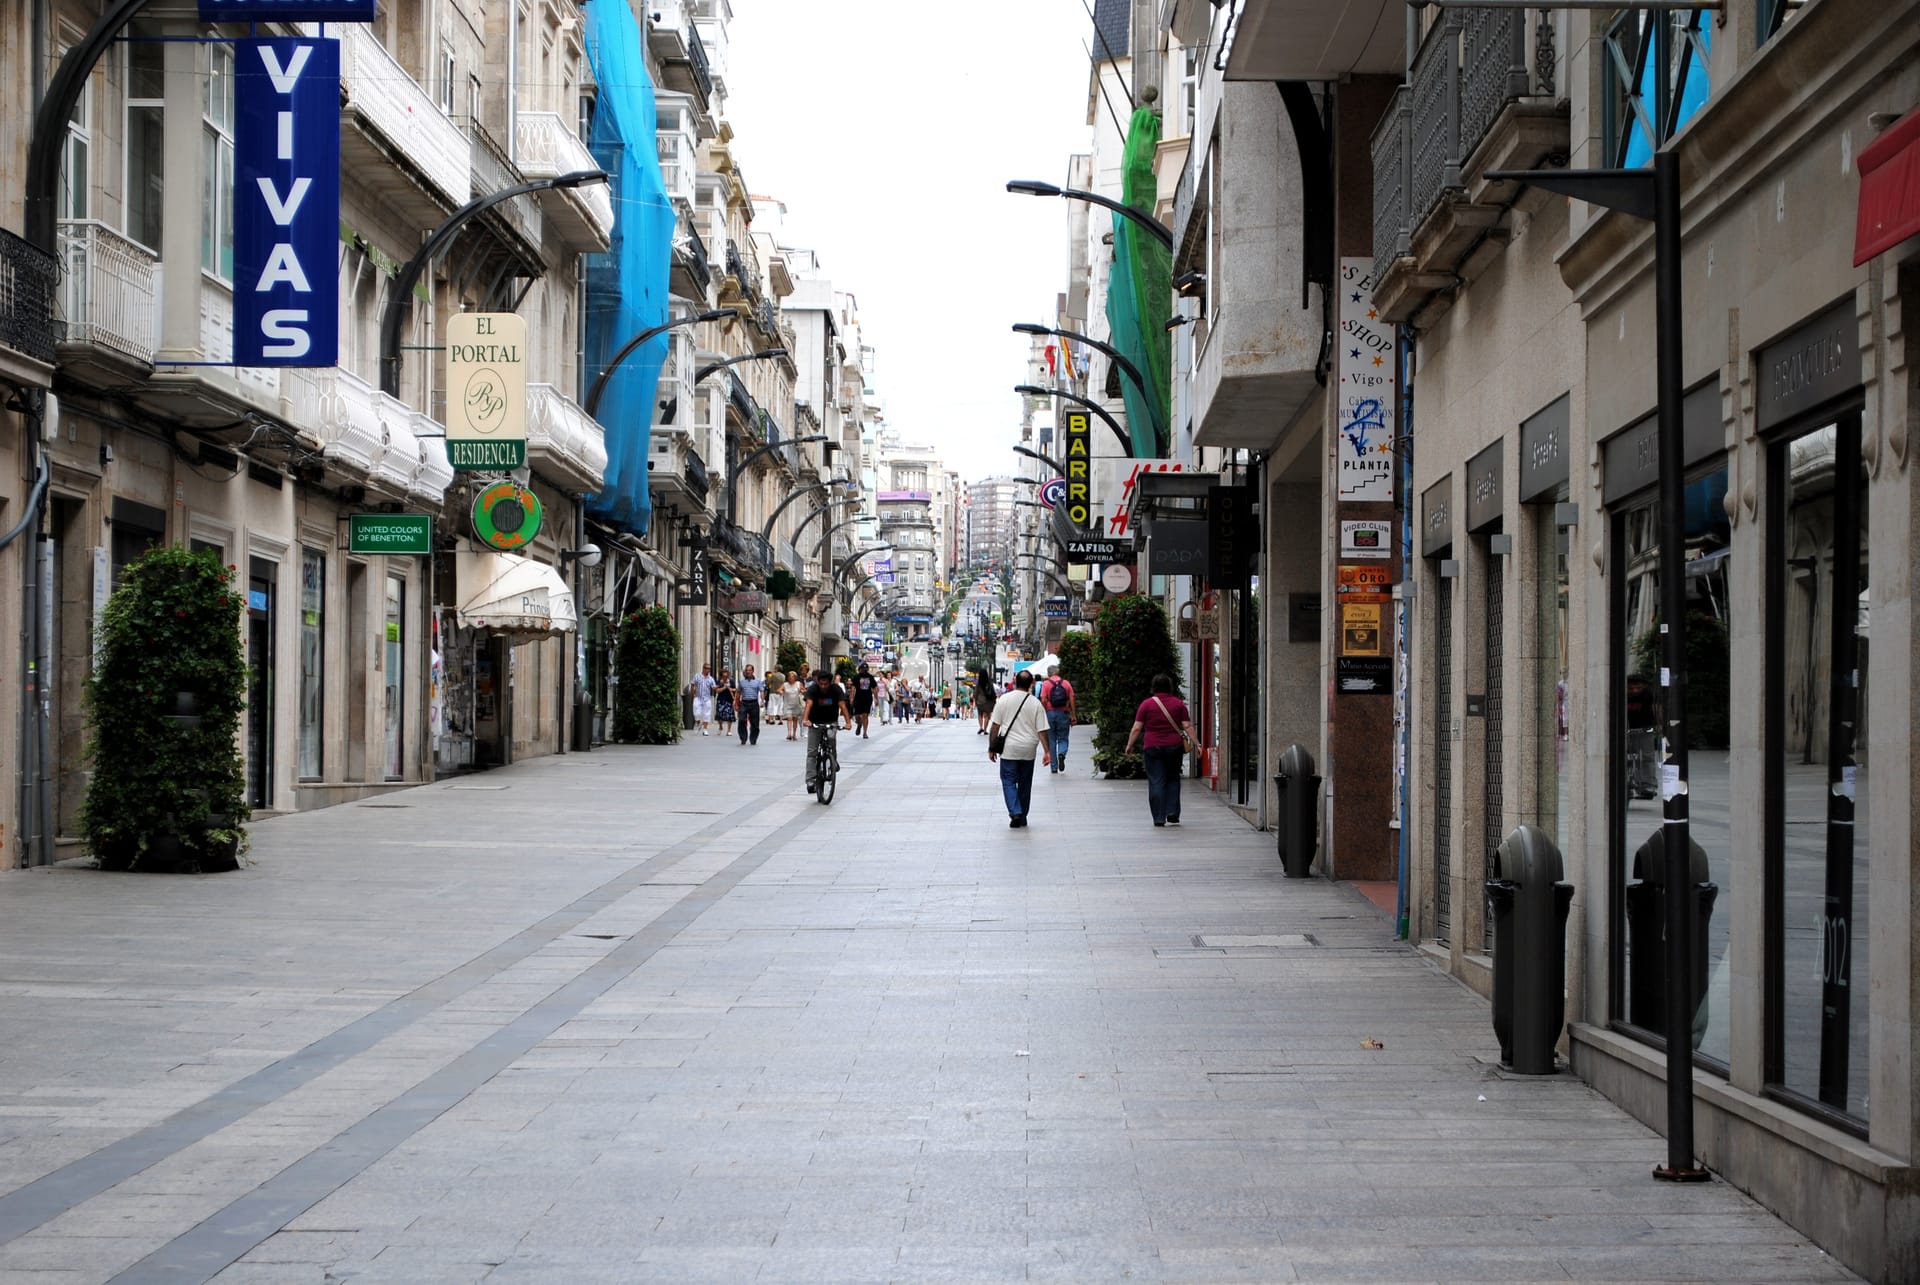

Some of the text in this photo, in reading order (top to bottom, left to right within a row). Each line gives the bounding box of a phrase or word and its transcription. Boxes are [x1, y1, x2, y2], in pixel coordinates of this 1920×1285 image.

[256, 45, 312, 359] VIVAS
[1343, 266, 1375, 291] SE
[476, 317, 496, 335] EL
[1343, 319, 1393, 353] SHOP
[451, 344, 521, 363] PORTAL
[1352, 373, 1384, 387] Vigo
[453, 443, 518, 465] RESIDENCIA
[1069, 415, 1087, 523] BARRO
[1344, 460, 1390, 471] PLANTA
[1047, 485, 1066, 501] C&
[357, 526, 423, 534] UNITED COLORS
[1343, 522, 1389, 533] VIDEO CLUB
[357, 534, 369, 542] OF
[1069, 543, 1114, 553] ZAFIRO
[693, 550, 704, 595] ZARA
[1360, 573, 1385, 583] ORO
[1813, 913, 1848, 986] 2012
